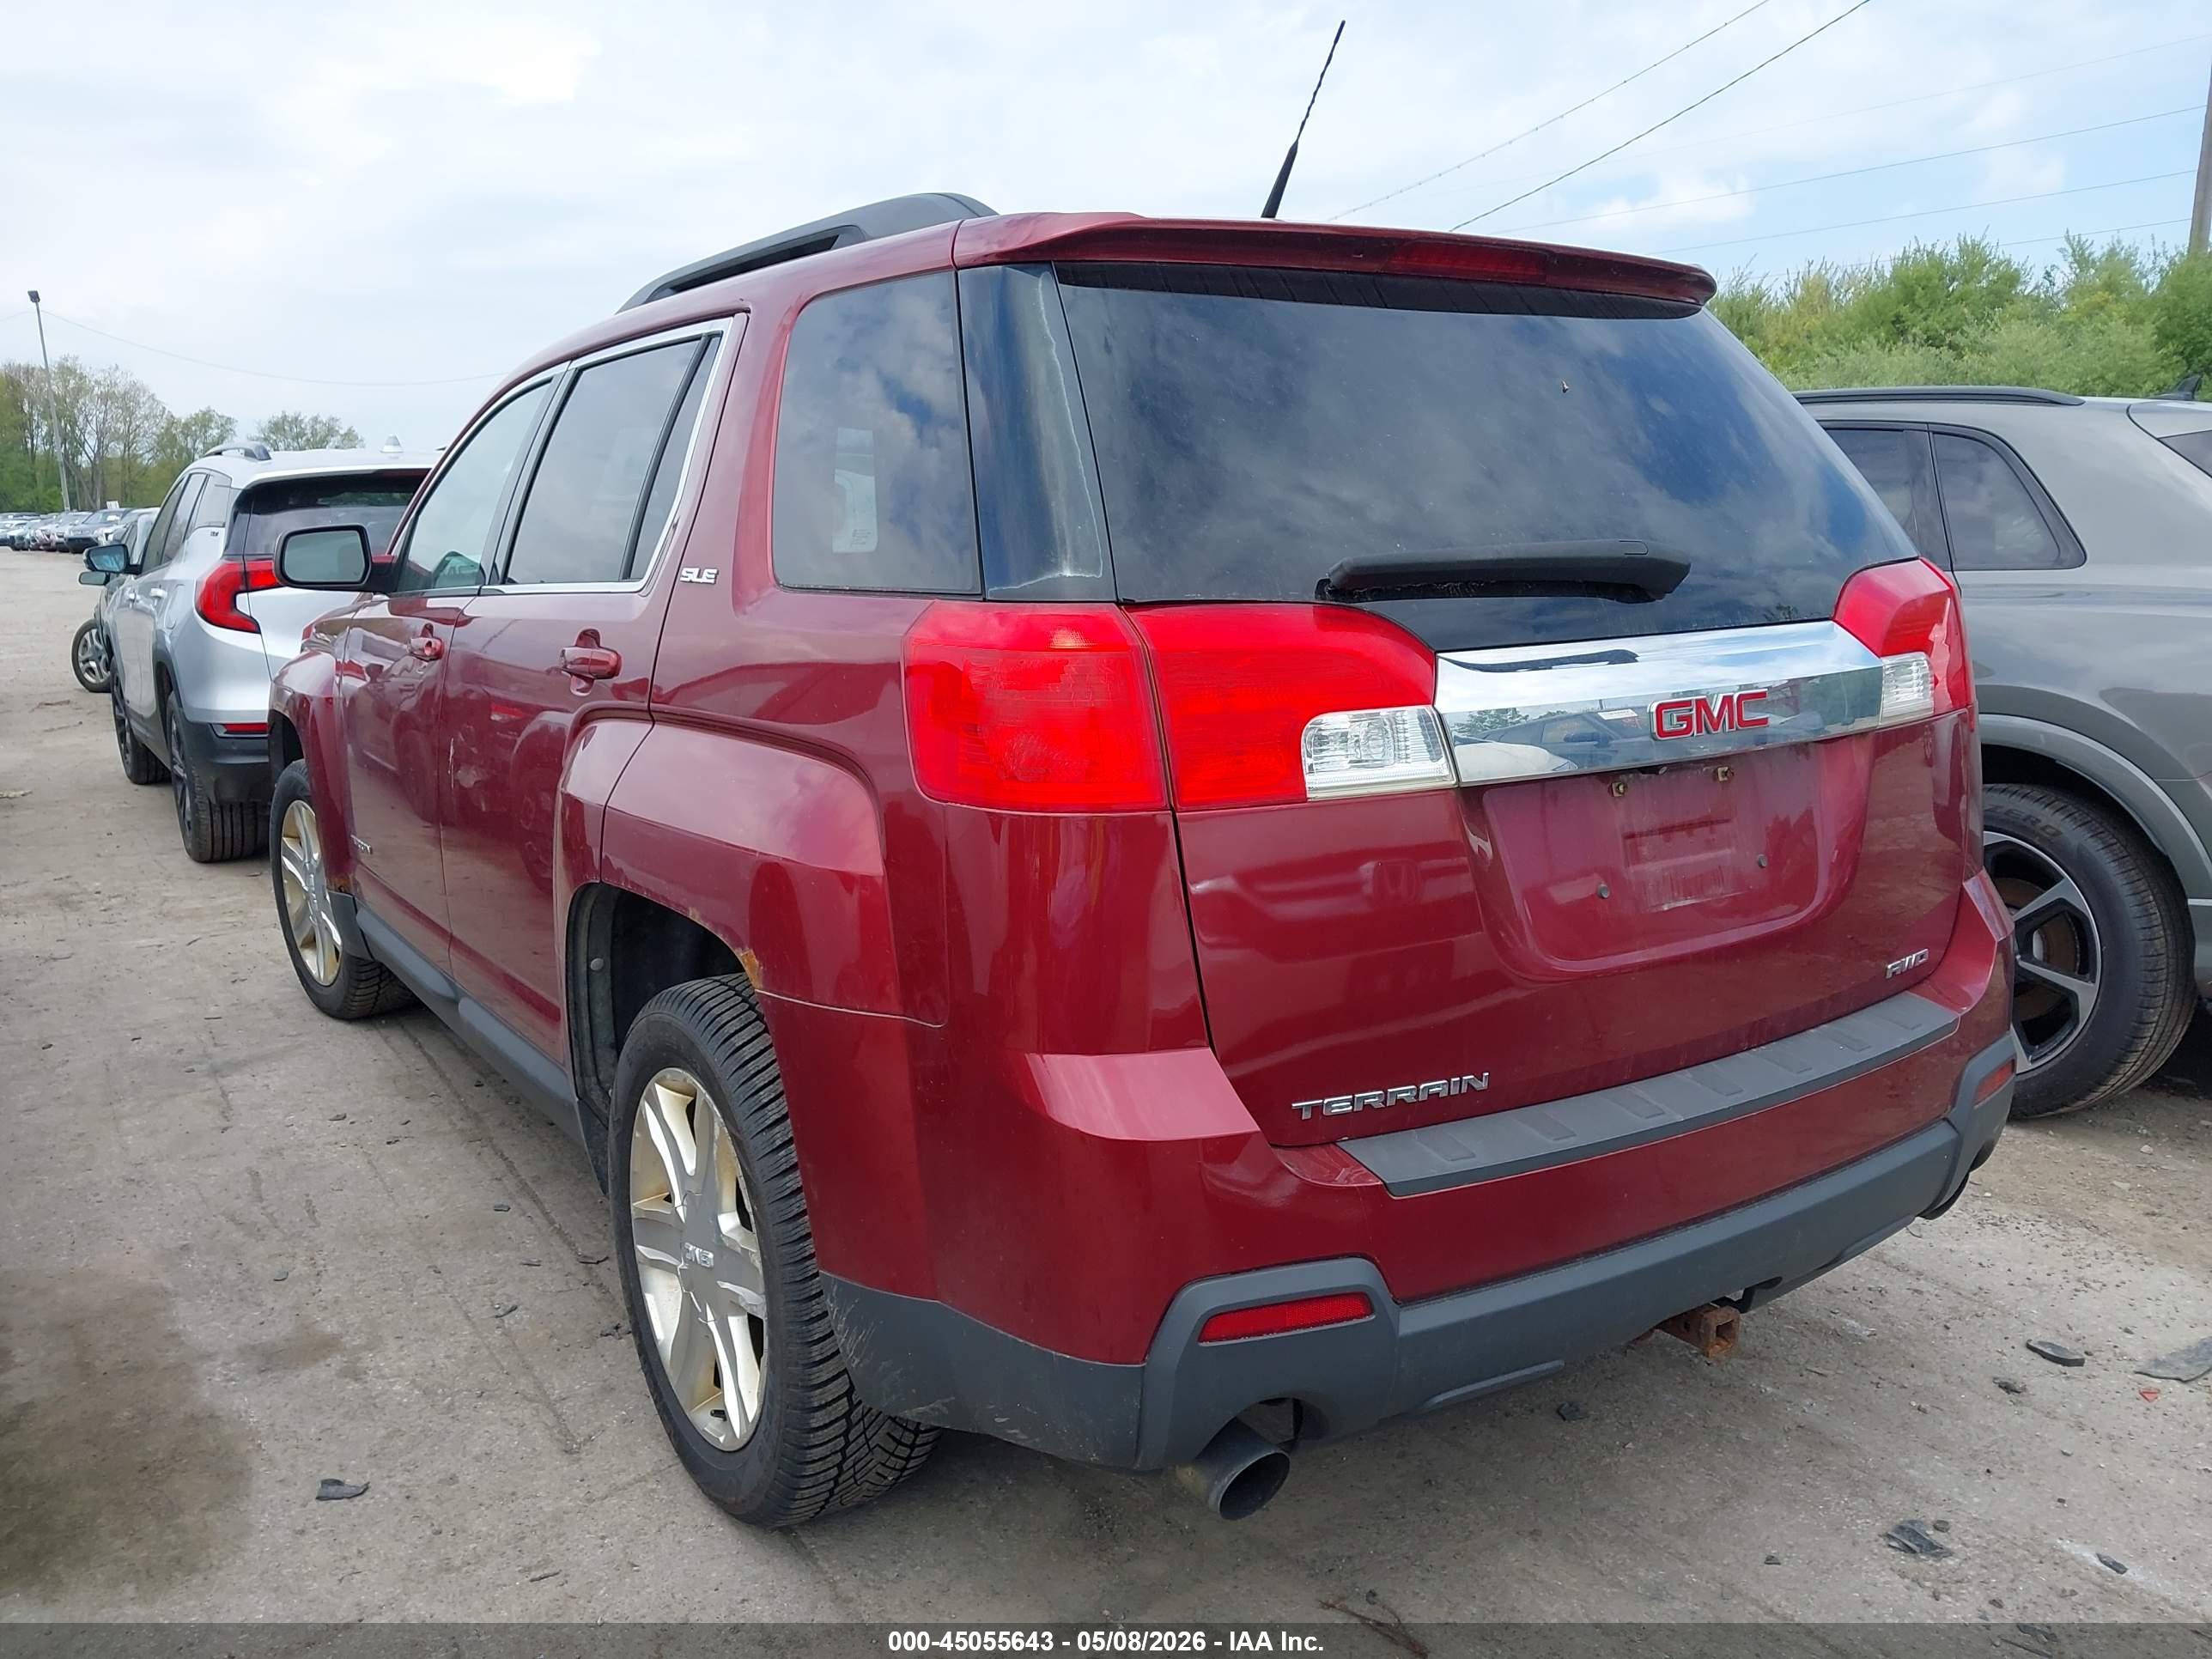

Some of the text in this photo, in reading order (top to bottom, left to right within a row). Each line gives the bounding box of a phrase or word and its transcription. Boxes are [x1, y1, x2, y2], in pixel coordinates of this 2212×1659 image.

[680, 568, 719, 585] SLE
[1648, 689, 1769, 740] GMC
[1291, 1072, 1490, 1121] TERRAIN
